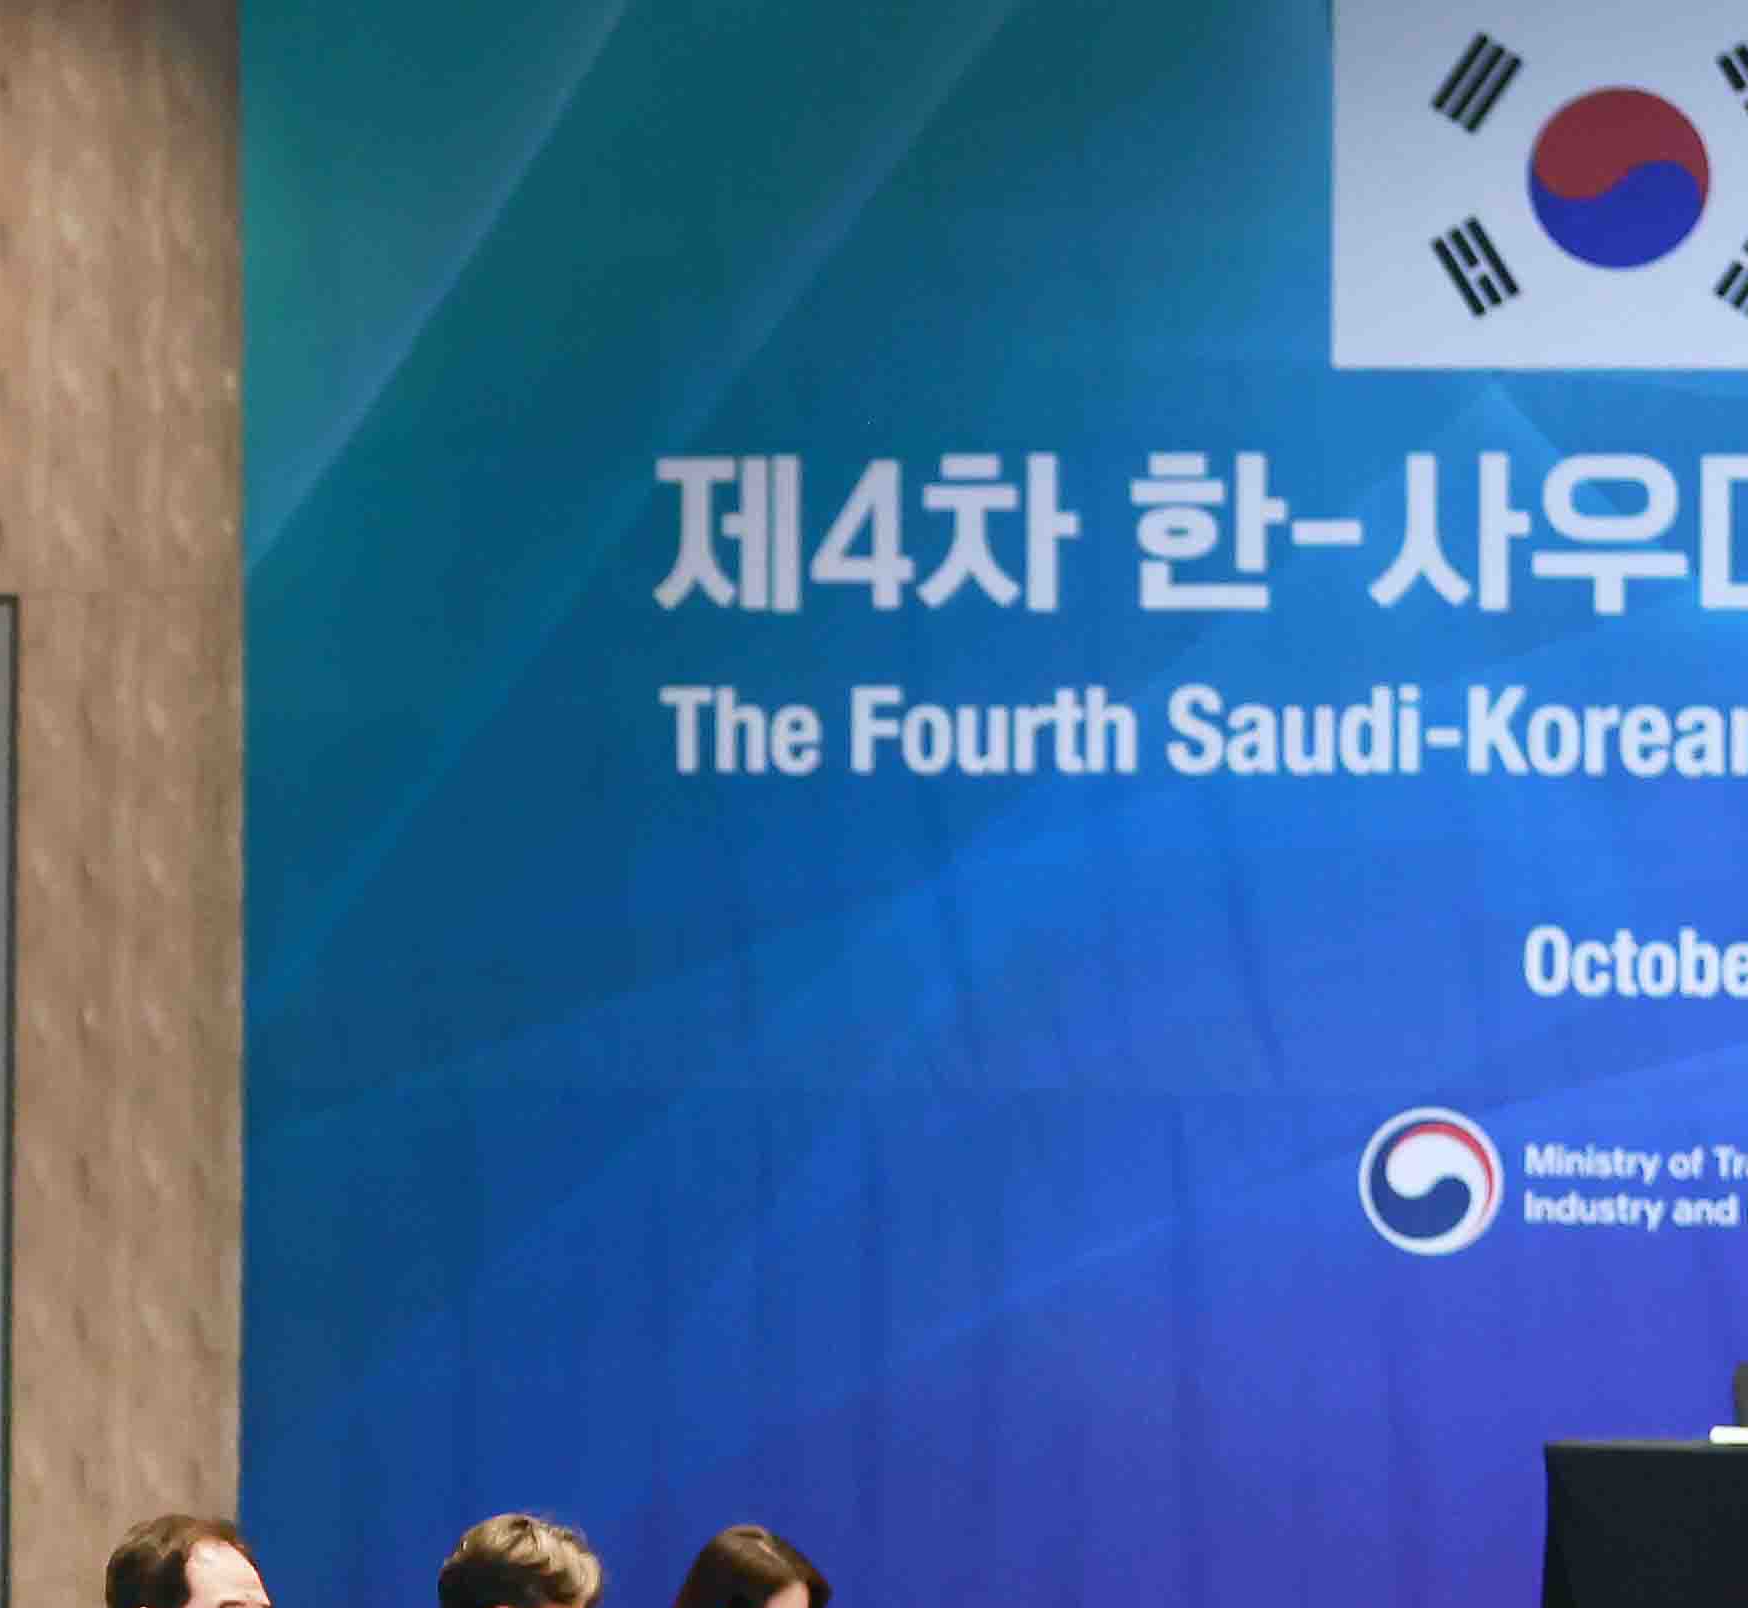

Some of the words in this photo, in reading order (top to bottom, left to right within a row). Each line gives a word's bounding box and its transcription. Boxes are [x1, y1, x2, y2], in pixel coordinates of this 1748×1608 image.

[656, 454, 1078, 612] 제4차
[661, 686, 820, 774] The
[851, 686, 1138, 775] Fourth
[1524, 1142, 1661, 1184] Ministry
[1666, 1146, 1705, 1180] of
[1523, 1190, 1665, 1231] Industry
[1671, 1194, 1740, 1226] and
